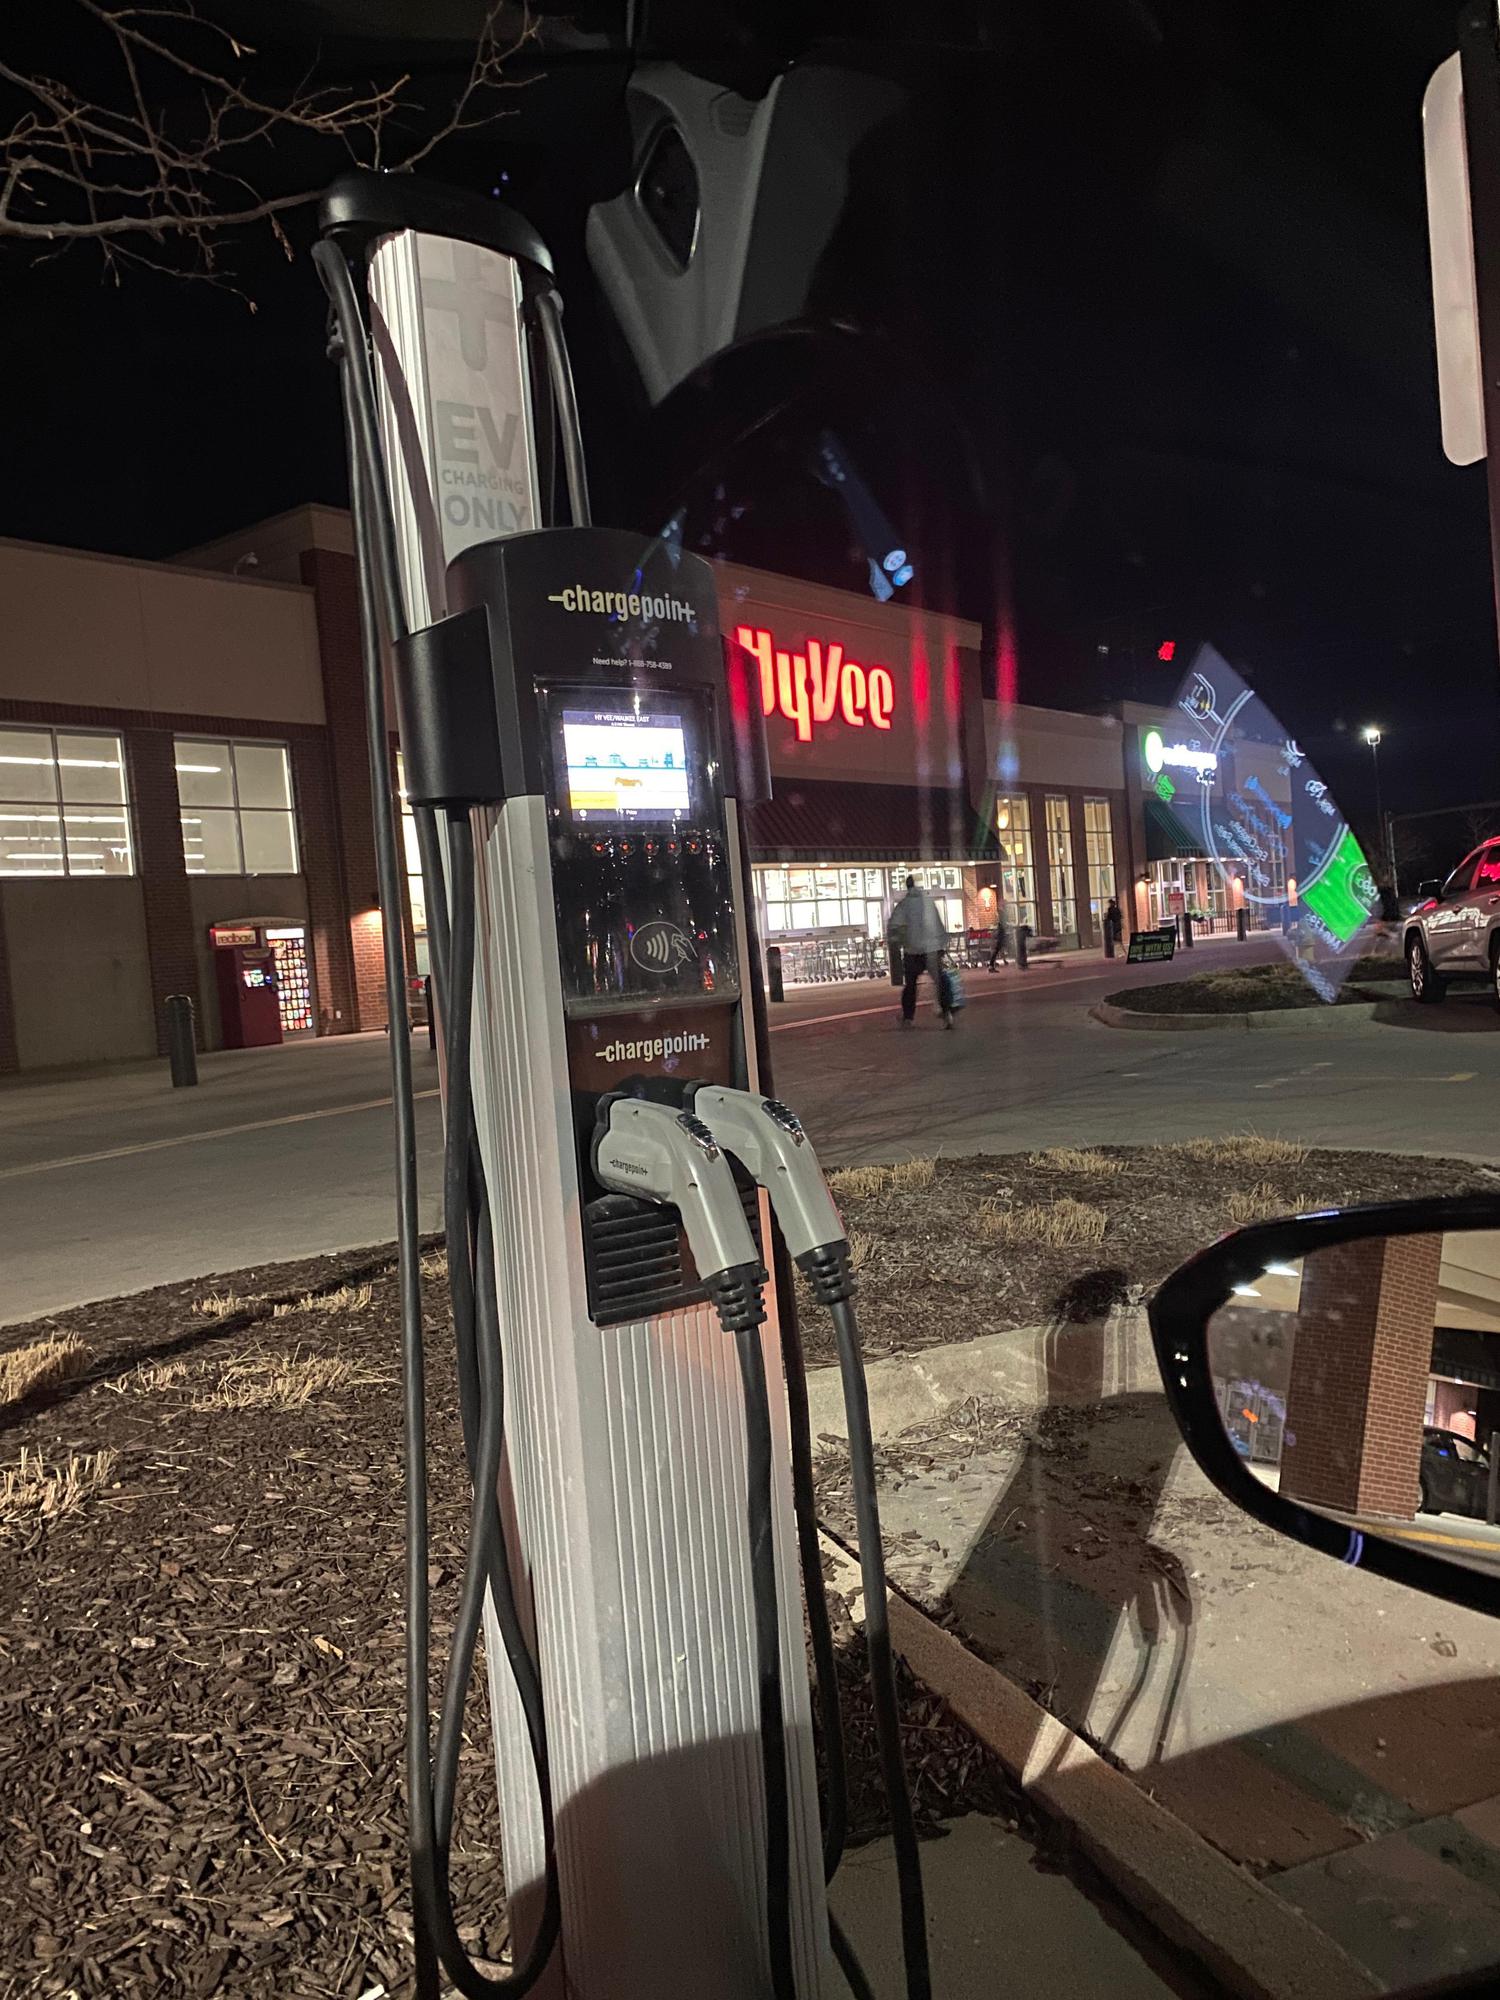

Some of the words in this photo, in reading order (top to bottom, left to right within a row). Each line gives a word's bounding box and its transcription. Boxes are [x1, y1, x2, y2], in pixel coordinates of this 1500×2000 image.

[437, 400, 520, 471] EV
[442, 469, 525, 495] CHARGING
[444, 494, 529, 533] ONLY
[592, 657, 610, 666] Need
[611, 658, 628, 668] help?
[217, 932, 253, 944] redbox
